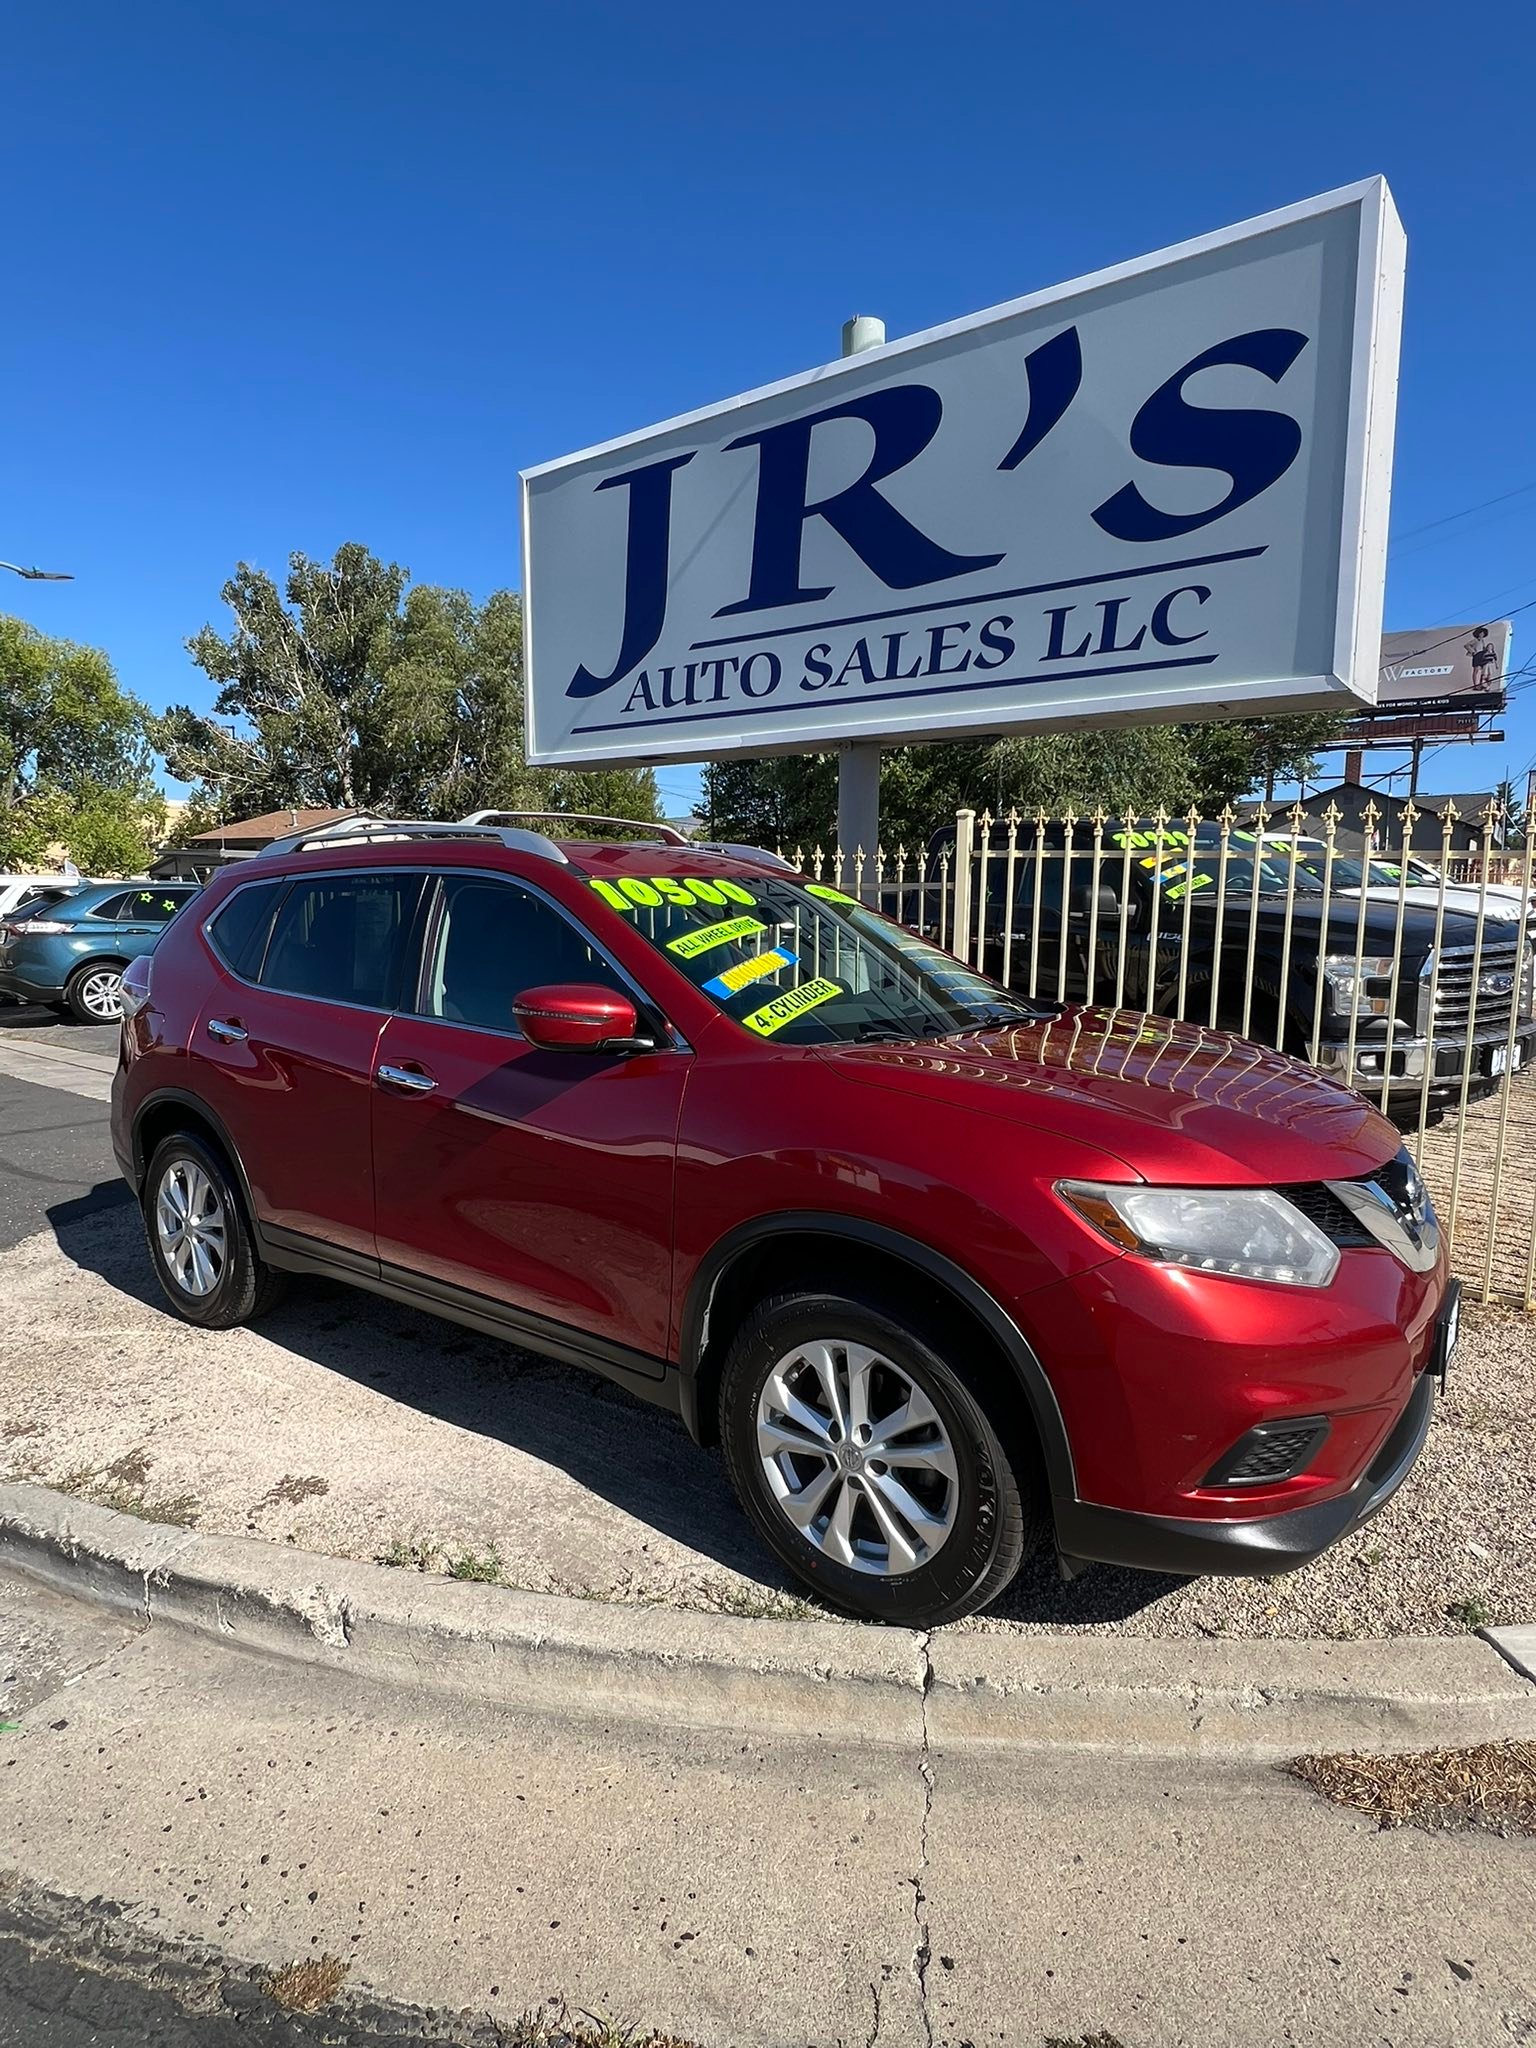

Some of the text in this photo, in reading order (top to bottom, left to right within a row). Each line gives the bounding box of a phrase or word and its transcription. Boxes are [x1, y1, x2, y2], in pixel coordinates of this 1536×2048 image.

[620, 586, 1212, 713] AUTO SALES LLC
[1405, 667, 1449, 676] FACTORY
[589, 877, 757, 911] 10500
[676, 918, 758, 954] ALL WHEEL DRIVE
